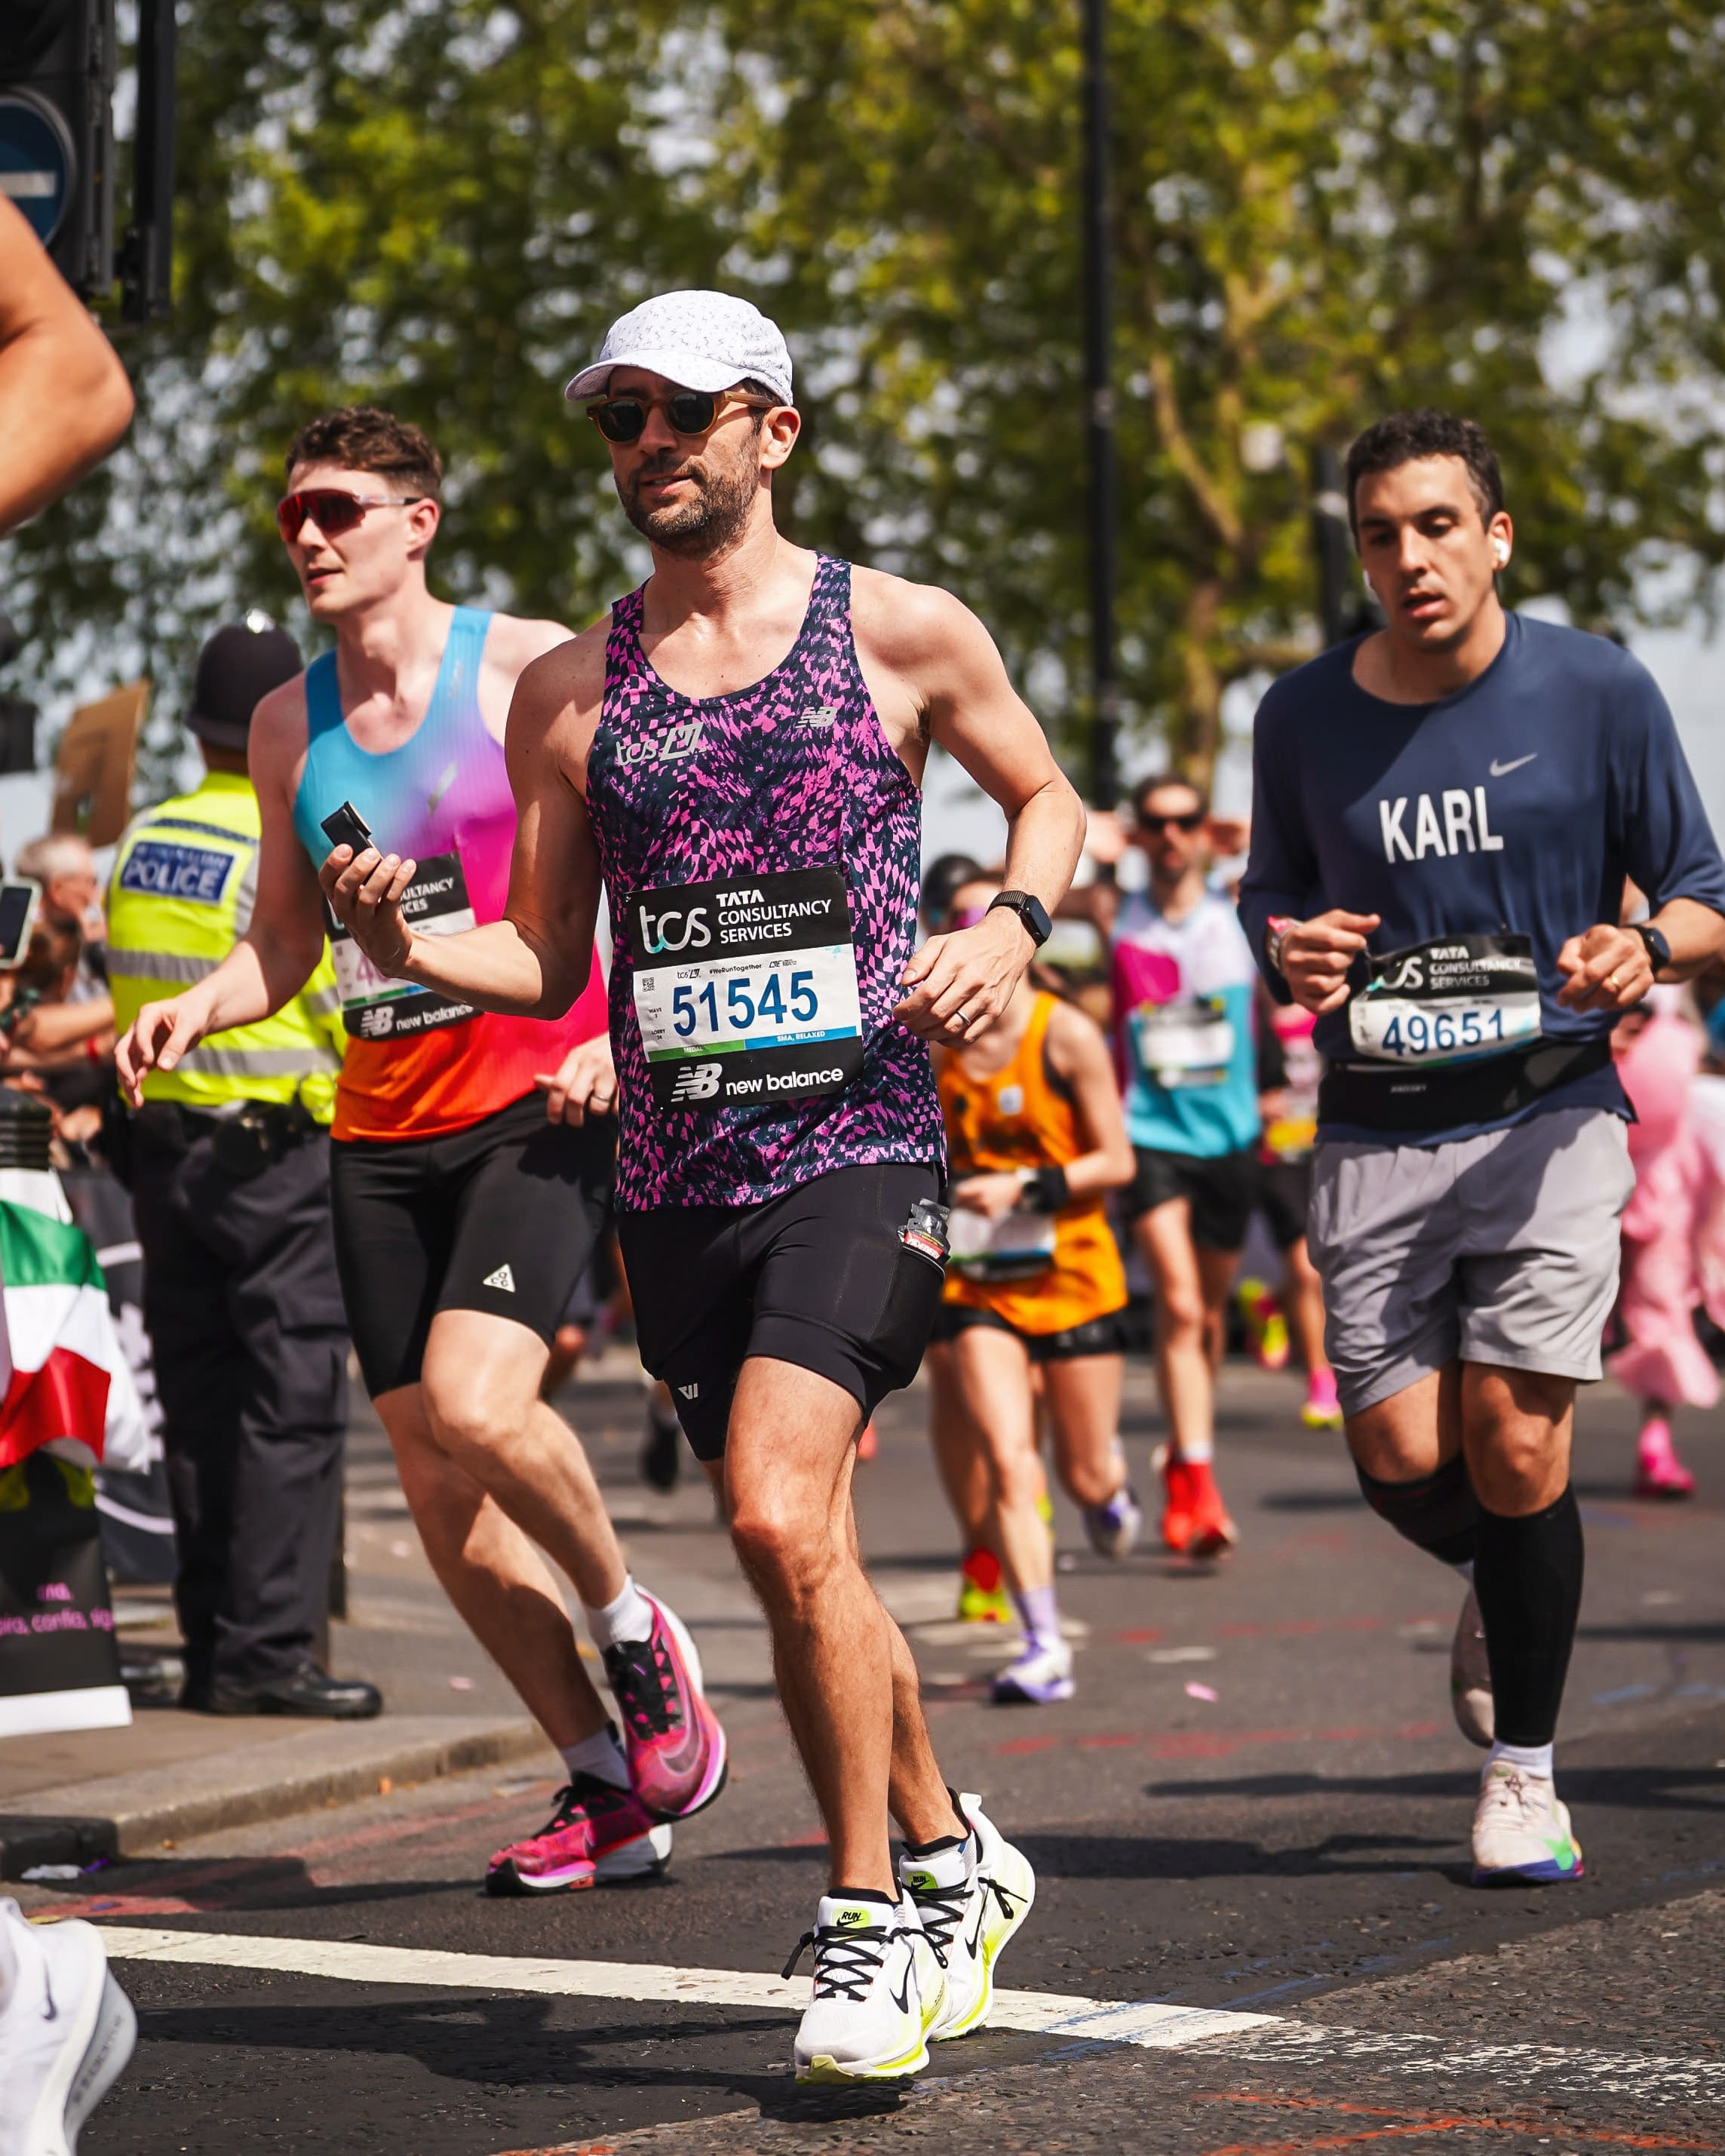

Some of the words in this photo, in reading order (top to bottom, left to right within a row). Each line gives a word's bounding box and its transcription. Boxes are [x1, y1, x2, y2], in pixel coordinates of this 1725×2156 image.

[615, 739, 657, 766] tcs
[1379, 786, 1504, 863] KARL
[124, 857, 219, 898] POLICE
[401, 877, 454, 900] ULTANCY
[716, 889, 765, 907] TATA
[717, 899, 832, 926] CONSULTANCY
[640, 905, 711, 954] tcs
[720, 922, 793, 944] SERVICES
[1429, 945, 1469, 960] TATA
[709, 963, 763, 974] #WeRunTogether
[1429, 958, 1522, 975] CONSULTANCY
[1429, 974, 1490, 990] SERVICES
[673, 971, 818, 1037] 51545
[396, 1015, 422, 1031] new
[1381, 1007, 1505, 1057] 49651
[796, 1031, 826, 1040] RELAXED
[683, 1045, 703, 1053] MEDAL
[726, 1078, 763, 1096] new
[766, 1068, 844, 1090] balance
[841, 1911, 861, 1921] RUN
